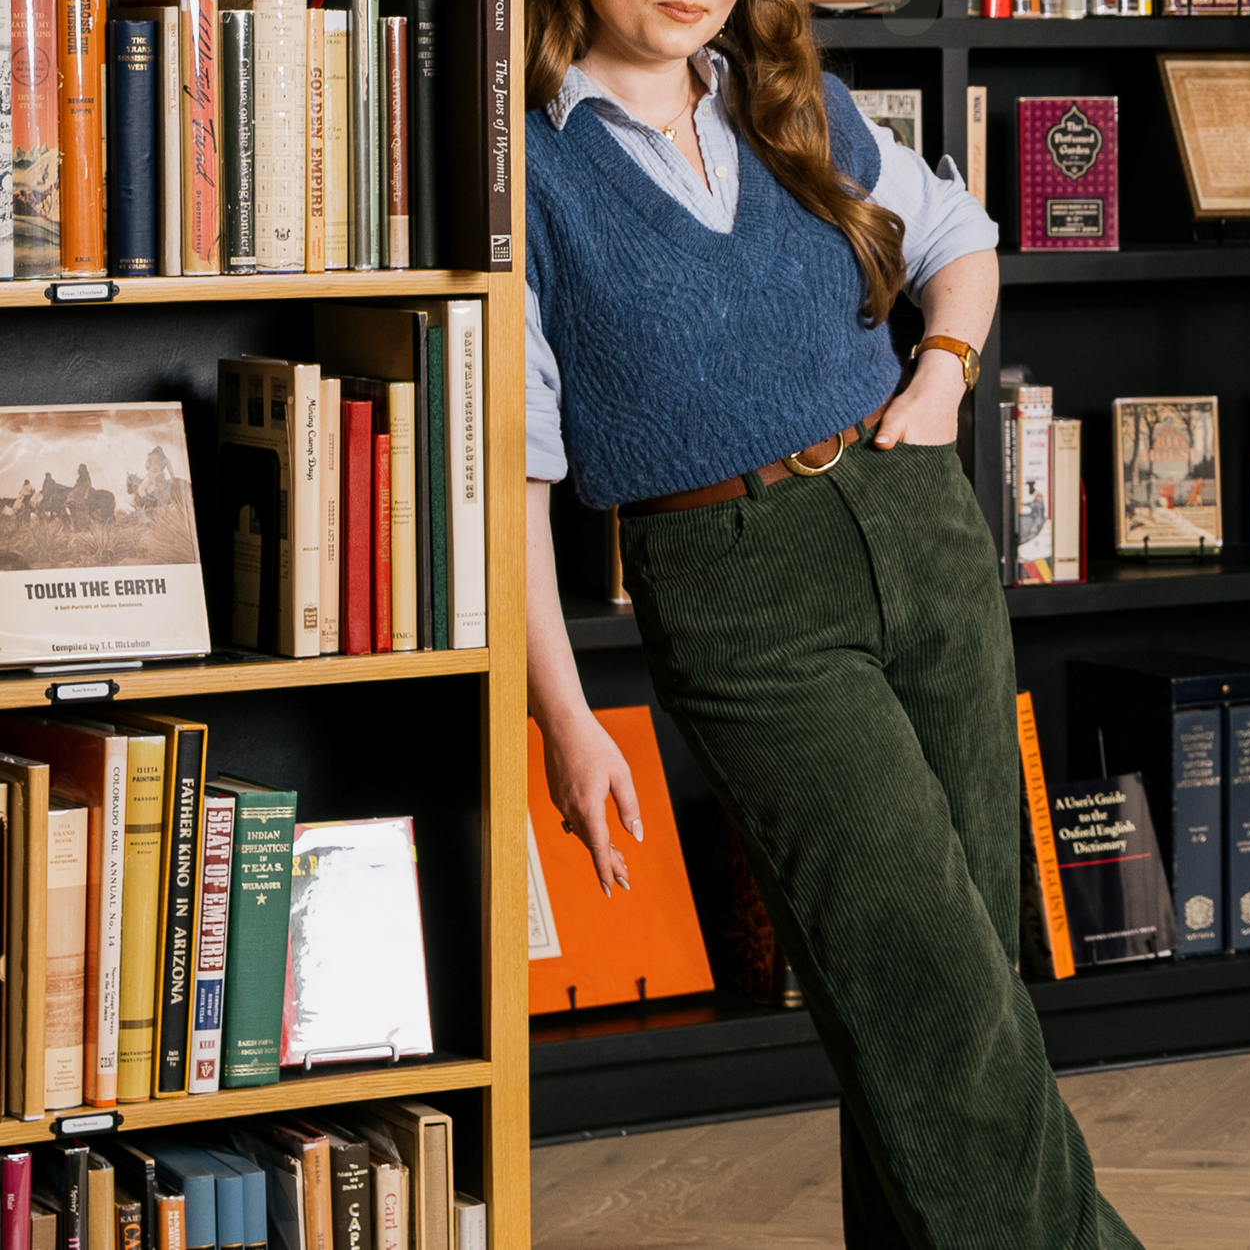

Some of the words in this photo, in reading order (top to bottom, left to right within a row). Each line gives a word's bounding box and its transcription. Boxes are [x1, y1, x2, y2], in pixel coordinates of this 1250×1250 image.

[67, 5, 77, 55] MISSOURI
[131, 36, 146, 44] THE
[80, 37, 88, 55] THE
[128, 63, 148, 71] WEST
[495, 59, 508, 83] The
[240, 58, 250, 105] Culture
[311, 66, 323, 139] GOLDEN
[491, 85, 507, 116] Jews
[240, 108, 250, 124] on
[492, 118, 507, 132] of
[1066, 121, 1082, 132] The
[240, 126, 250, 146] the
[1059, 144, 1090, 155] Garden
[239, 150, 251, 199] Moving
[493, 136, 507, 193] Wyoming
[310, 148, 323, 218] EMPIRE
[241, 201, 251, 252] Frontier
[464, 331, 474, 357] SAN
[306, 396, 317, 428] Mining
[464, 361, 474, 441] FRANCISCO
[306, 430, 317, 456] Camp
[306, 457, 317, 481] Days
[381, 488, 389, 517] BELL
[380, 520, 389, 563] RANCH
[25, 582, 77, 600] TOUCH
[80, 581, 110, 598] THE
[115, 578, 167, 596] EARTH
[51, 643, 88, 653] Compiled
[90, 642, 100, 652] by
[115, 640, 151, 650] McLuhan
[111, 766, 121, 826] COLORADO
[179, 777, 195, 838] FATHER
[1055, 798, 1065, 810] A
[1094, 790, 1127, 805] Guide
[1078, 813, 1090, 823] to
[1091, 809, 1108, 822] the
[110, 830, 119, 855] RAIL
[206, 810, 232, 860] SEAT
[247, 830, 280, 840] INDIAN
[1059, 825, 1096, 840] Oxford
[1096, 820, 1136, 838] English
[1073, 839, 1127, 855] Dictionary
[176, 843, 192, 887] KINO
[204, 864, 229, 887] OF
[242, 863, 283, 873] TEXAS.
[109, 861, 118, 908] ANNUAL
[175, 898, 189, 916] IN
[108, 912, 116, 930] No.
[200, 892, 228, 969] EMPIRE
[108, 935, 116, 947] 14
[170, 926, 187, 1005] ARIZONA
[384, 1193, 398, 1230] Carl
